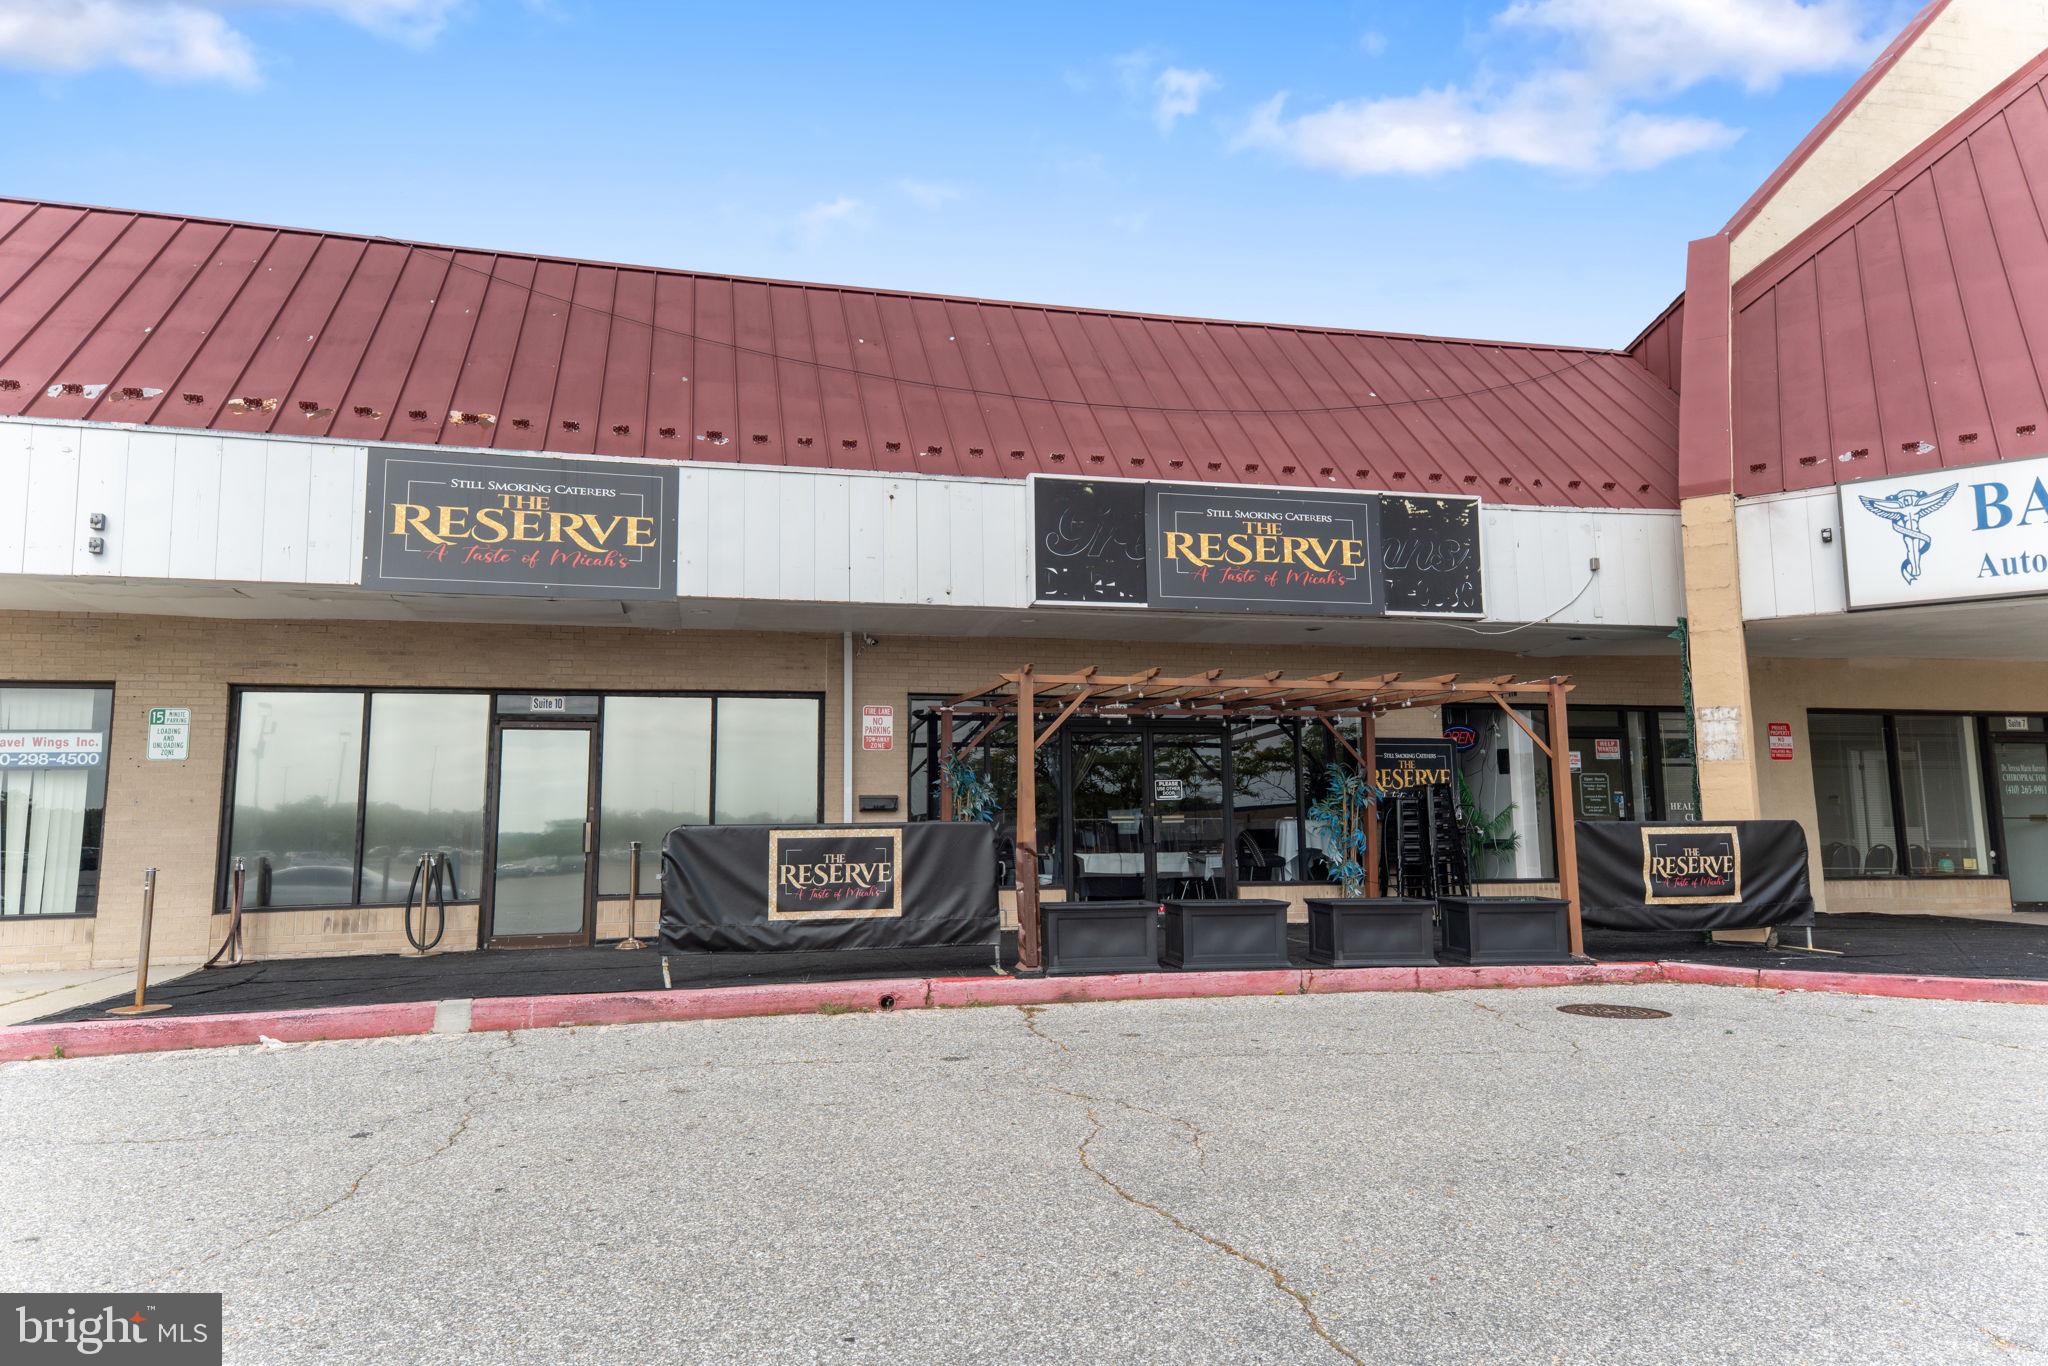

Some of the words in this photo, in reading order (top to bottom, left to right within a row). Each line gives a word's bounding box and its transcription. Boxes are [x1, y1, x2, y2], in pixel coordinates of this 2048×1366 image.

[451, 478, 485, 490] STILL
[488, 481, 551, 494] SMOKING
[554, 484, 616, 497] CATERERS
[498, 493, 550, 511] THE
[1968, 476, 2048, 531] BA
[1206, 508, 1232, 518] STILL
[1234, 510, 1283, 521] SMOKING
[1285, 512, 1332, 523] CATERERS
[388, 503, 657, 553] RESERVE
[1242, 521, 1284, 536] THE
[423, 543, 448, 562] A
[461, 544, 517, 565] Taste
[521, 549, 541, 568] of
[550, 549, 631, 569] Micah's
[1162, 531, 1366, 572] RESERVE
[1976, 550, 2048, 579] Auto
[1188, 566, 1209, 584] A
[1218, 566, 1260, 584] Taste
[1264, 570, 1279, 586] of
[1286, 569, 1346, 586] Micah's
[533, 698, 553, 709] Suite
[555, 698, 563, 709] 10
[152, 712, 164, 724] 15
[879, 708, 891, 716] LANE
[872, 717, 884, 726] NO
[864, 726, 891, 735] PARKING
[32, 737, 70, 750] Wings
[76, 737, 99, 748] Inc.
[0, 753, 100, 766] 0-298-4500
[1399, 760, 1416, 769] THE
[2002, 773, 2047, 782] CHIROPRACTOR
[1670, 802, 1694, 811] HEAL
[822, 853, 847, 864] THE
[1682, 848, 1700, 856] THE
[1651, 856, 1734, 878] RESERVE
[779, 862, 893, 890] RESERVE
[834, 888, 842, 901] of
